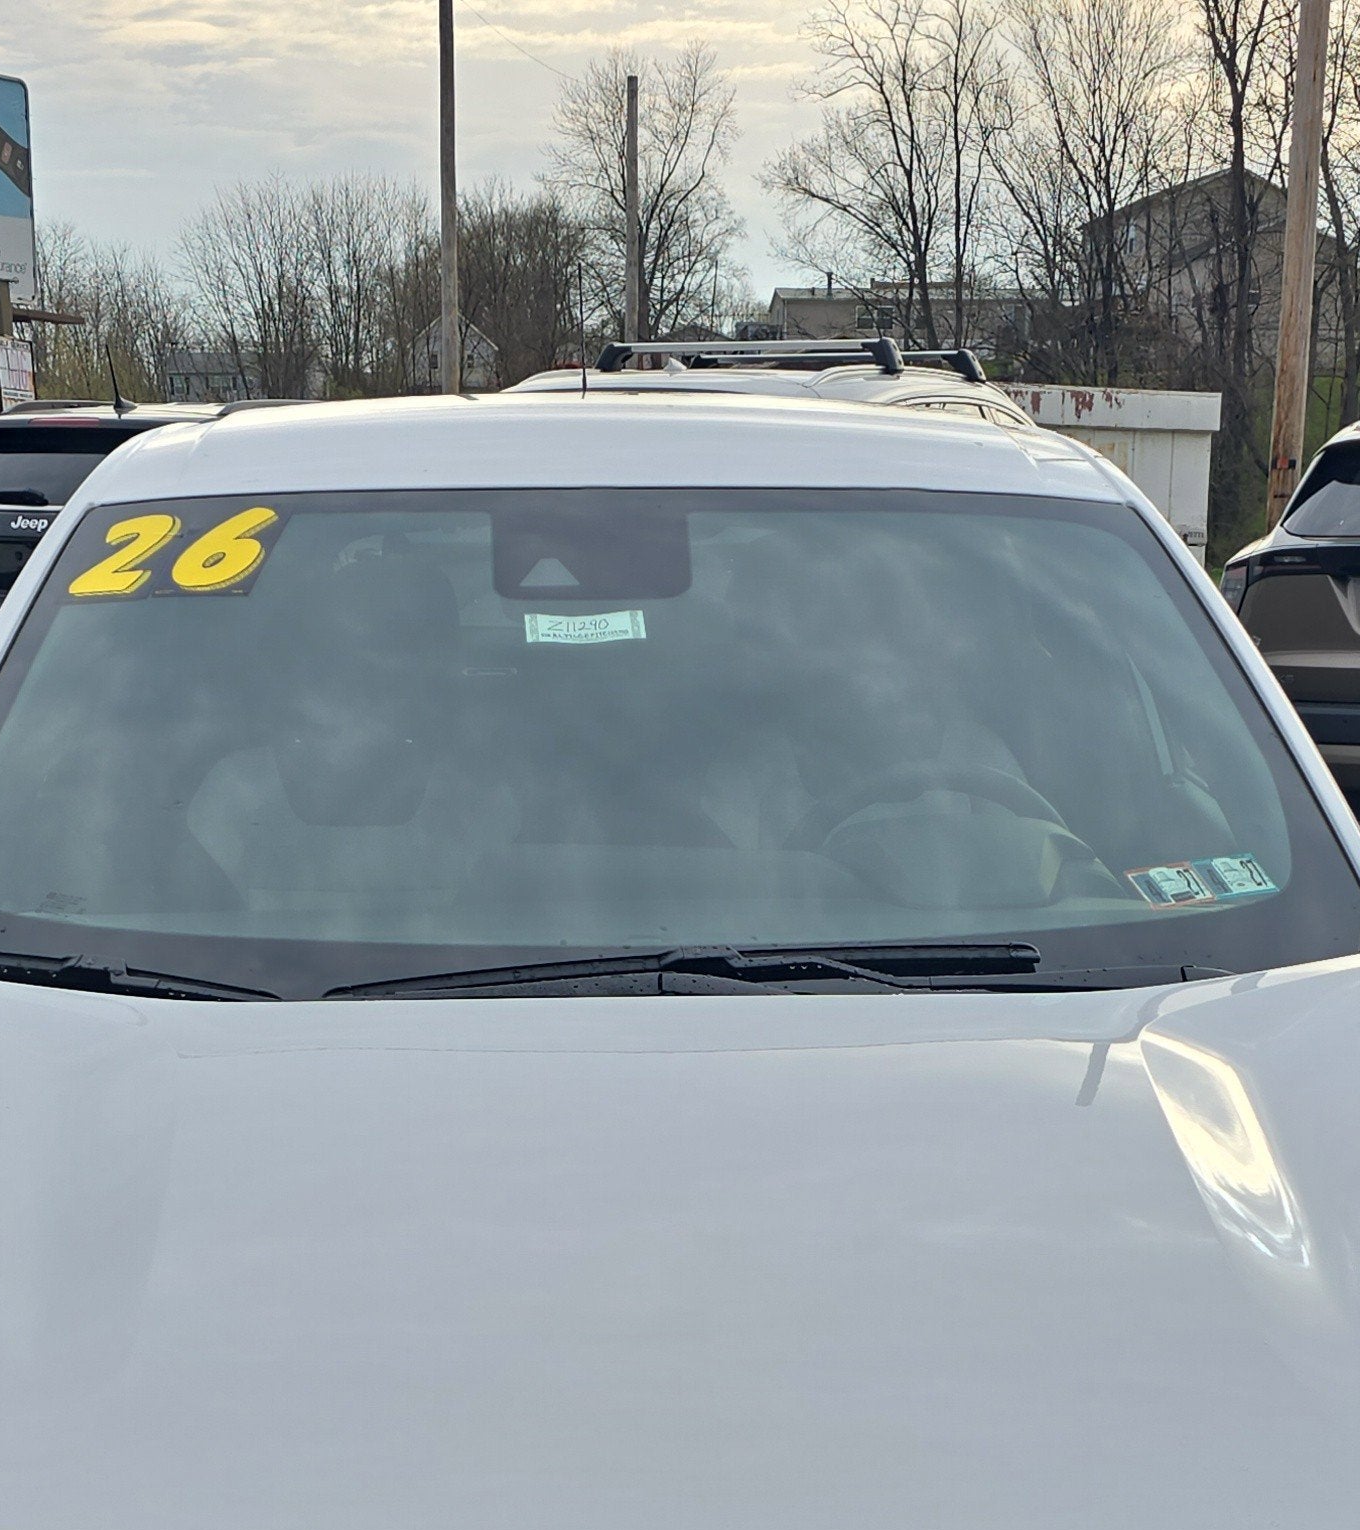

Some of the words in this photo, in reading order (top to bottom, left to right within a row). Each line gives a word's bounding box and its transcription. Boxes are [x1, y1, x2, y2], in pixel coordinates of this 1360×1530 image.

[10, 515, 49, 532] Jeep
[68, 505, 280, 597] 26
[1176, 868, 1206, 897] 27
[1239, 858, 1268, 887] 27
